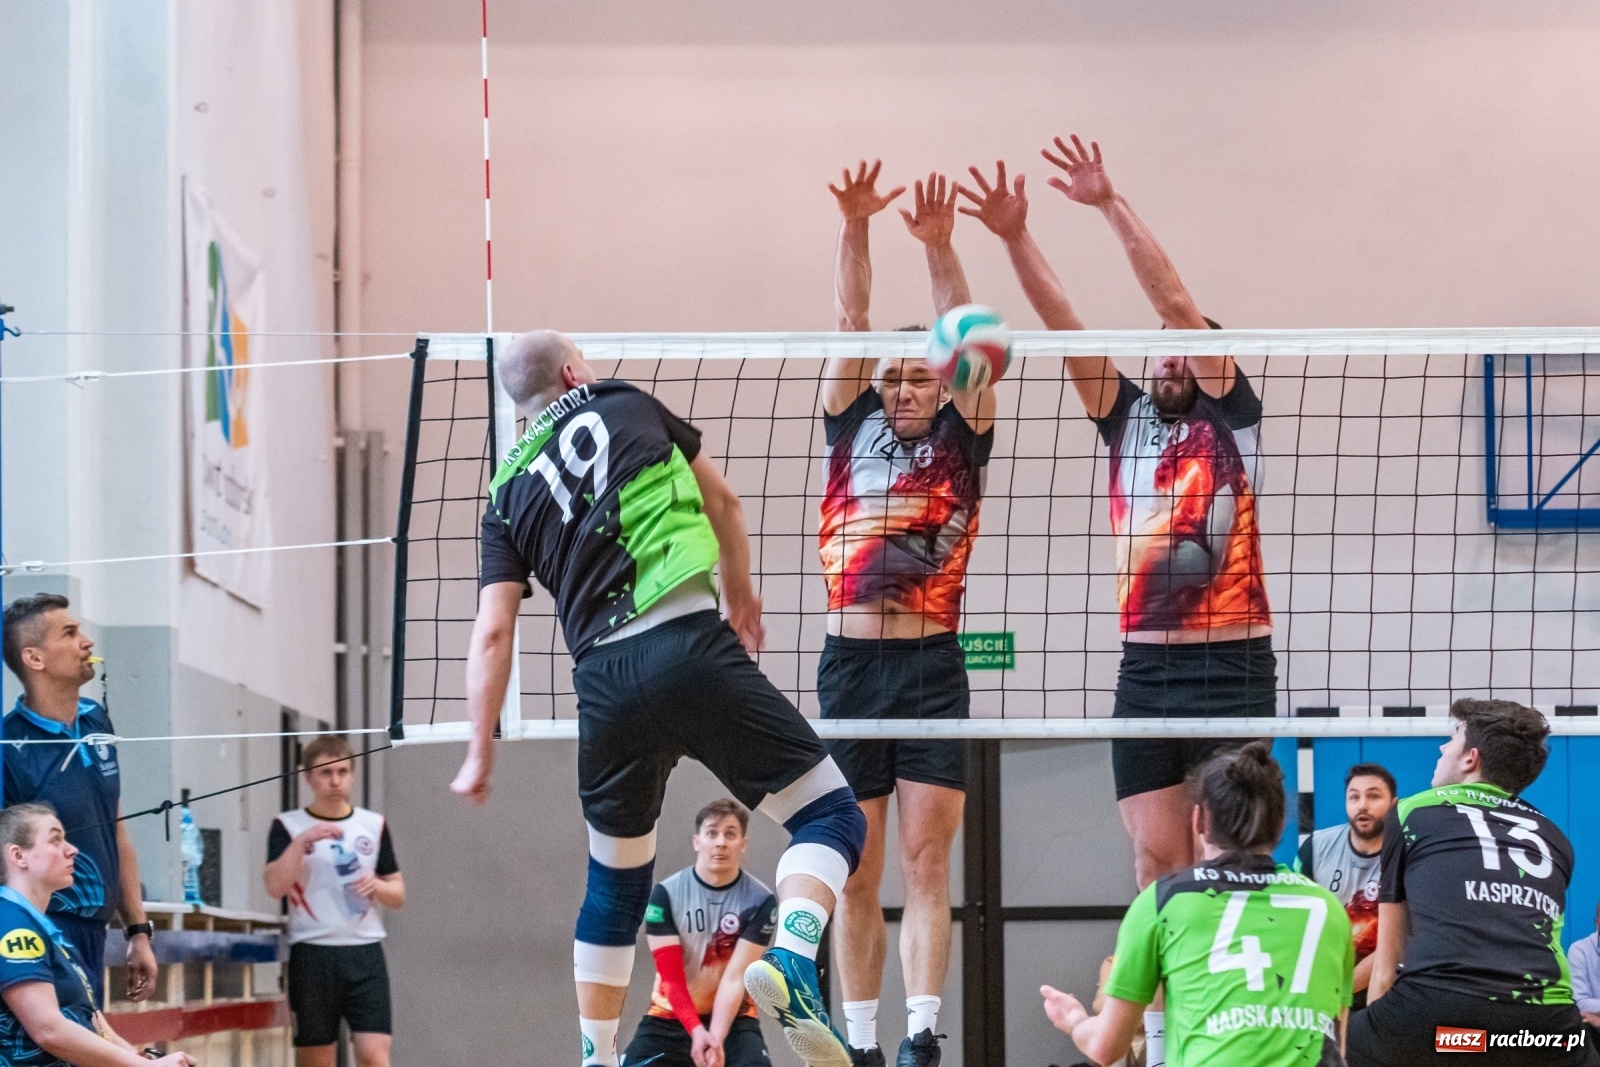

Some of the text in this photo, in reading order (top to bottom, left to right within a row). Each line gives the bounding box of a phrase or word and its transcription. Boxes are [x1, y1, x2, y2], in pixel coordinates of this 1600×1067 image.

[869, 432, 900, 462] 14
[527, 411, 610, 525] 19
[1454, 803, 1553, 880] 13
[1193, 867, 1220, 881] KS
[1329, 869, 1343, 893] 8
[685, 907, 706, 934] 10
[6, 935, 40, 954] HK
[1208, 890, 1329, 994] 47
